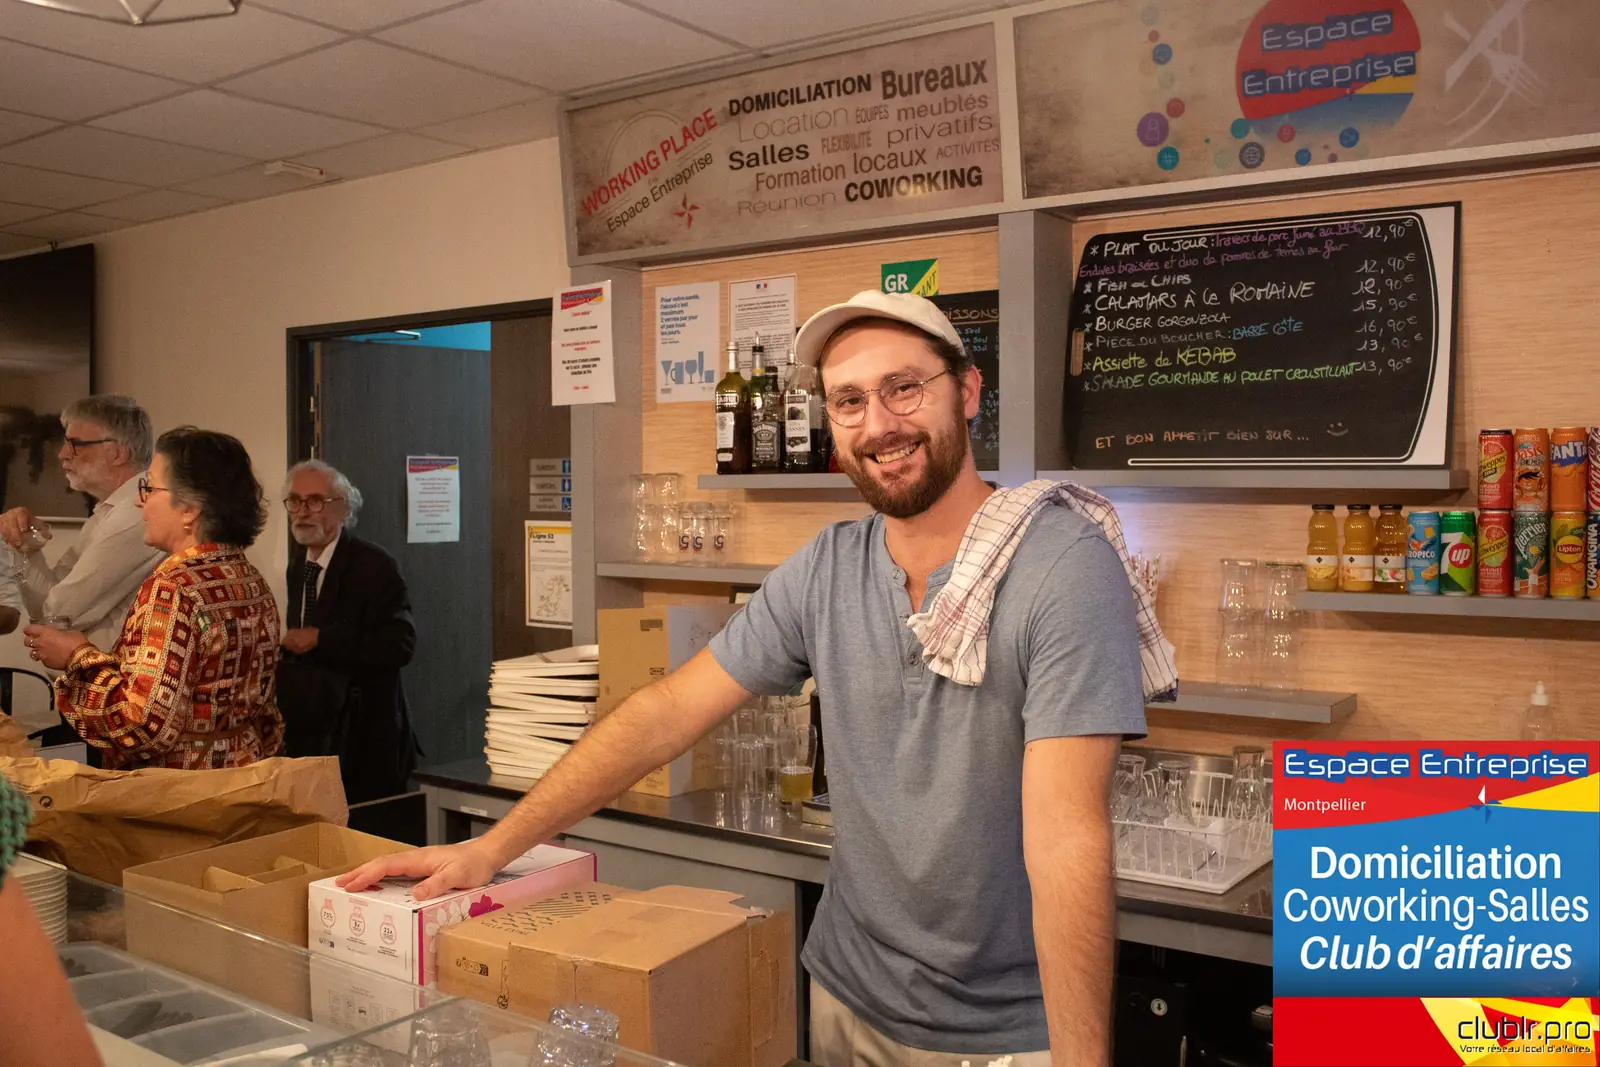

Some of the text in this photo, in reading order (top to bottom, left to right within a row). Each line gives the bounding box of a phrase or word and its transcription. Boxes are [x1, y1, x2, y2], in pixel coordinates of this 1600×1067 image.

[1263, 14, 1392, 50] Espace
[881, 59, 988, 100] Bureaux
[1244, 56, 1414, 95] Entreprise
[729, 74, 871, 116] DOMICILIATION
[897, 94, 989, 121] meublés
[738, 107, 848, 143] Location
[887, 112, 993, 148] privatifs
[581, 107, 719, 217] WORKING PLACE
[728, 143, 810, 171] Salles
[853, 148, 928, 174] locaux
[755, 163, 846, 192] Formation
[844, 166, 983, 202] COWORKING
[606, 152, 713, 233] Espace Entreprise
[737, 192, 836, 215] Réunion
[1104, 242, 1140, 257] PLAT
[1079, 264, 1116, 277] Endives
[1164, 255, 1179, 269] et
[884, 273, 909, 293] GR
[1095, 292, 1178, 311] CALAMARS
[1095, 315, 1152, 332] BURGER
[1157, 312, 1231, 328] GORGONZOLA
[1092, 351, 1148, 373] Assiette
[1091, 373, 1145, 392] SALADE
[1148, 370, 1220, 387] GOURMANDE
[1241, 369, 1285, 385] POULET
[1285, 361, 1361, 381] CROUSTILLANT
[1095, 434, 1115, 449] ET
[1126, 430, 1154, 446] BON
[1408, 550, 1436, 559] ROPICO
[1514, 522, 1548, 560] Perrier
[1558, 545, 1581, 553] Lipton
[1587, 523, 1598, 590] ORANGINA
